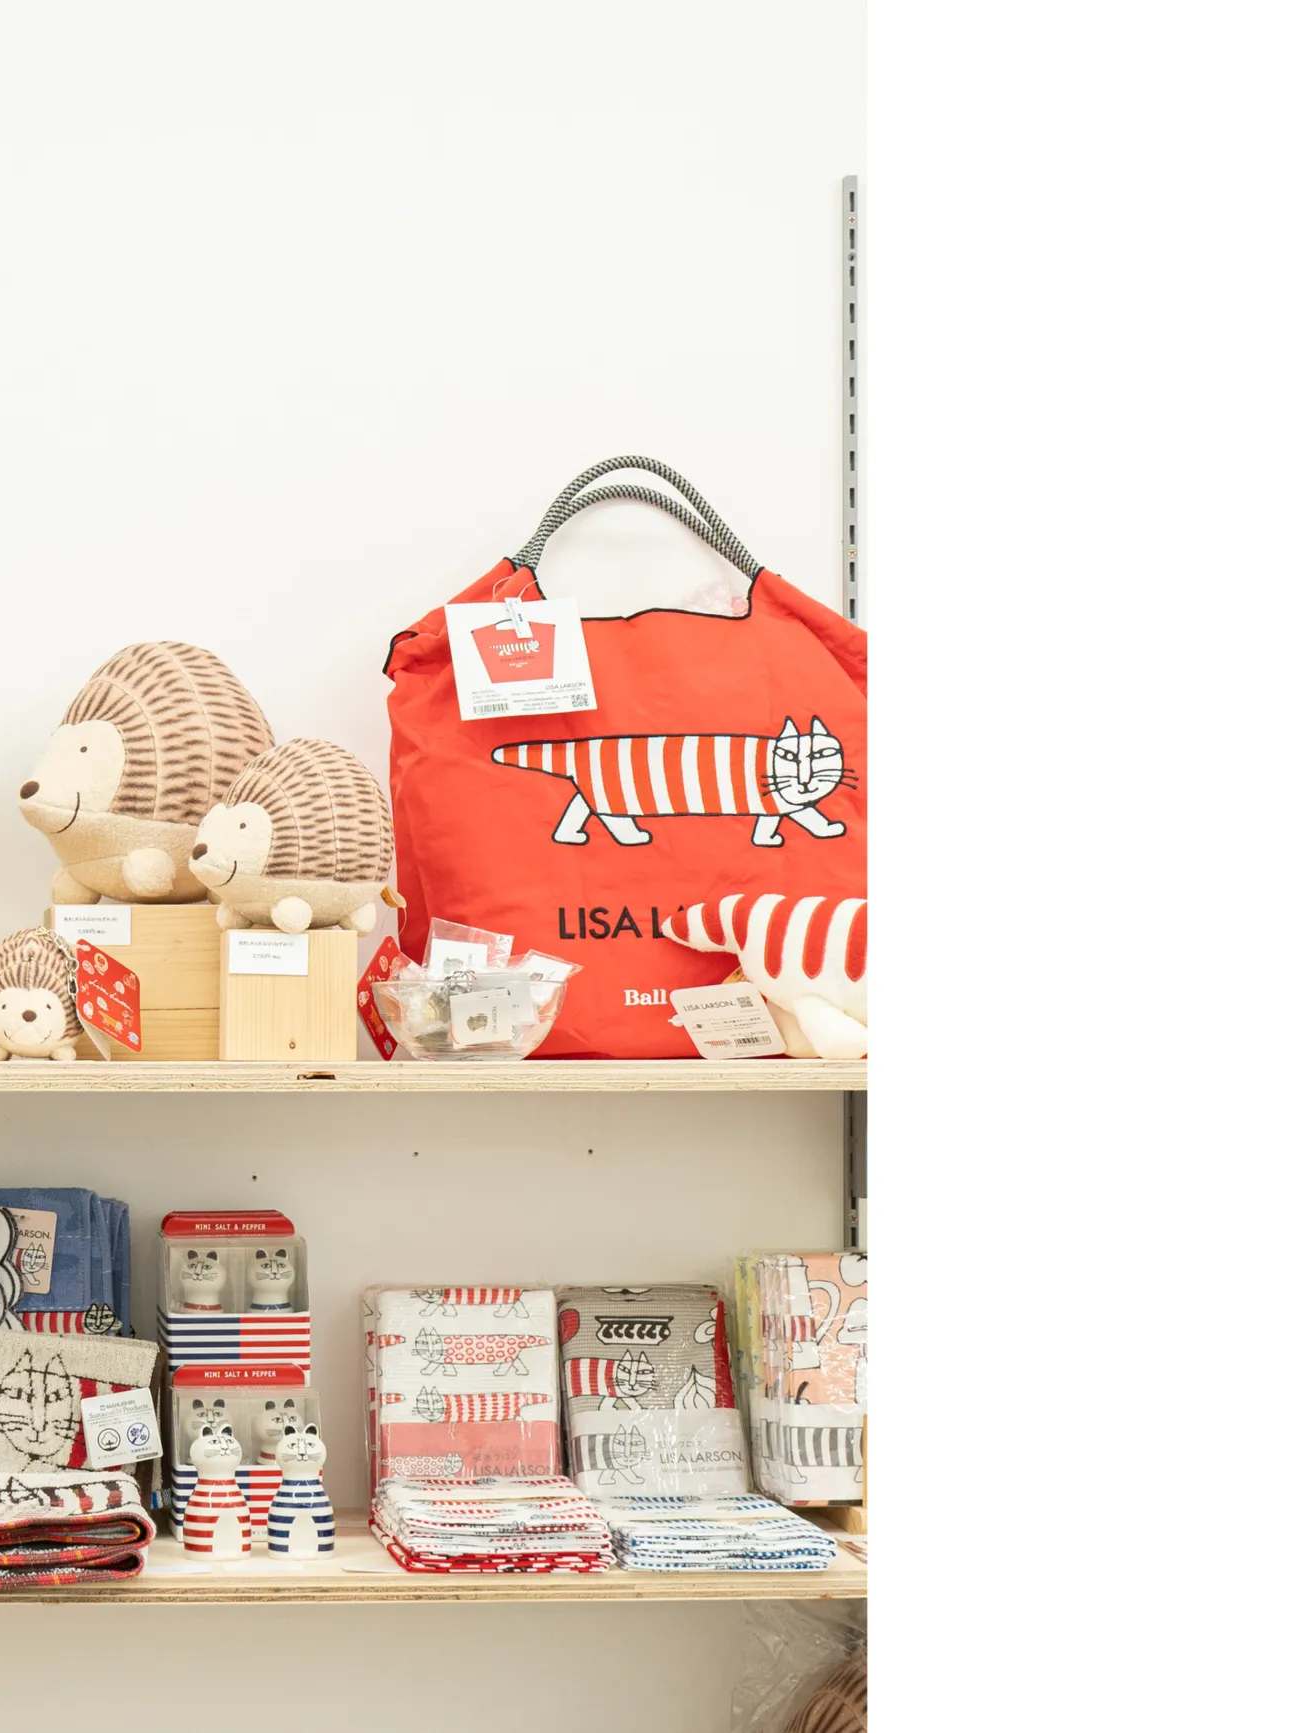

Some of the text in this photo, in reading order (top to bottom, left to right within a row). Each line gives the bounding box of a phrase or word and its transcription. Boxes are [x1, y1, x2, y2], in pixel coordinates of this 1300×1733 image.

[558, 905, 643, 939] LISA
[623, 988, 668, 1006] Ball
[682, 1004, 701, 1012] LISA
[195, 1223, 211, 1231] MIMI
[215, 1223, 231, 1231] SALT
[224, 1370, 241, 1378] SALT
[252, 1370, 277, 1378] PEPPER
[659, 1453, 688, 1464] LISA
[474, 1464, 502, 1477] LISA
